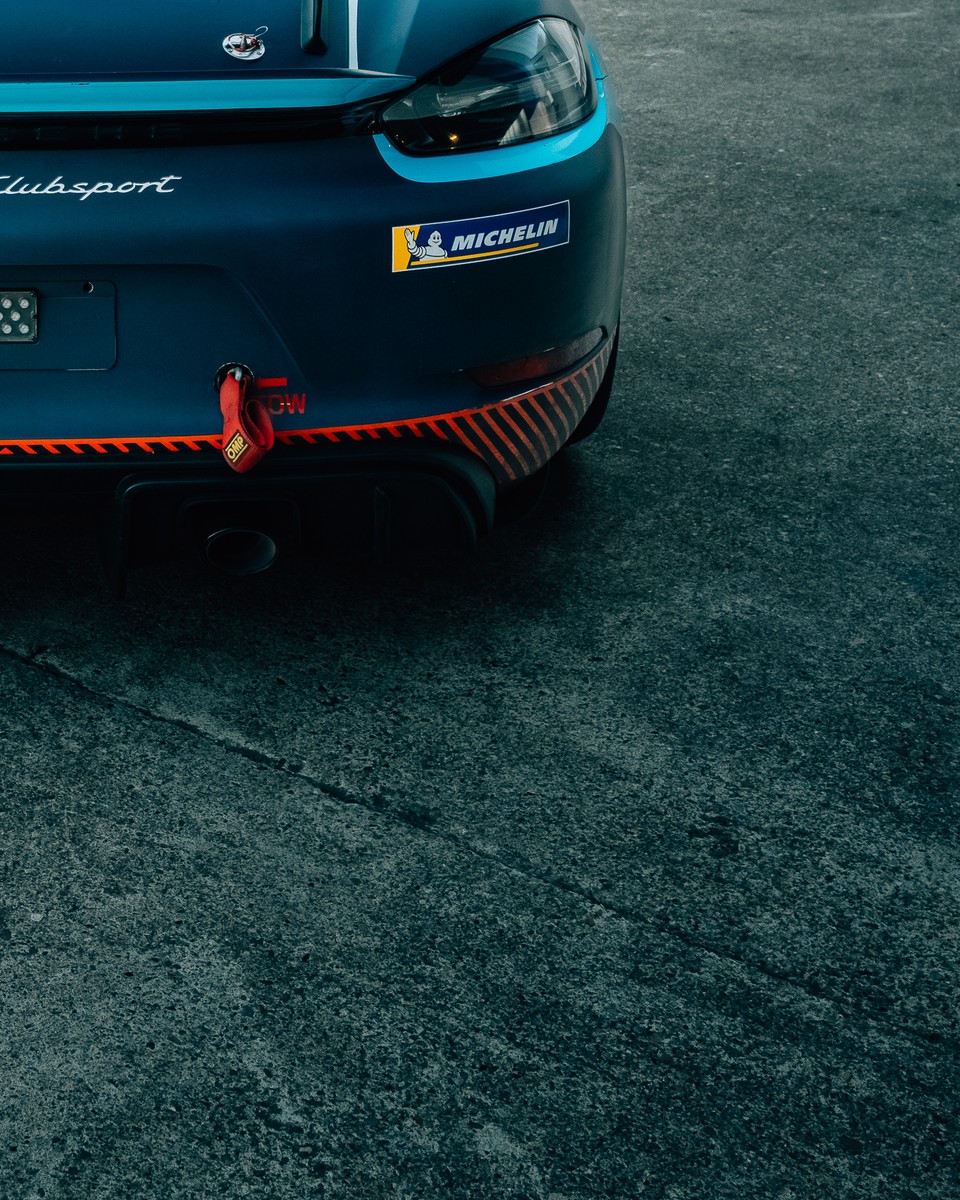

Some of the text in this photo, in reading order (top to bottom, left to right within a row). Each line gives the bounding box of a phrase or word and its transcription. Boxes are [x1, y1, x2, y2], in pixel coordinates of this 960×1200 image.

[451, 218, 559, 252] MICHELIN
[256, 392, 306, 415] OW
[227, 435, 245, 460] OMP
